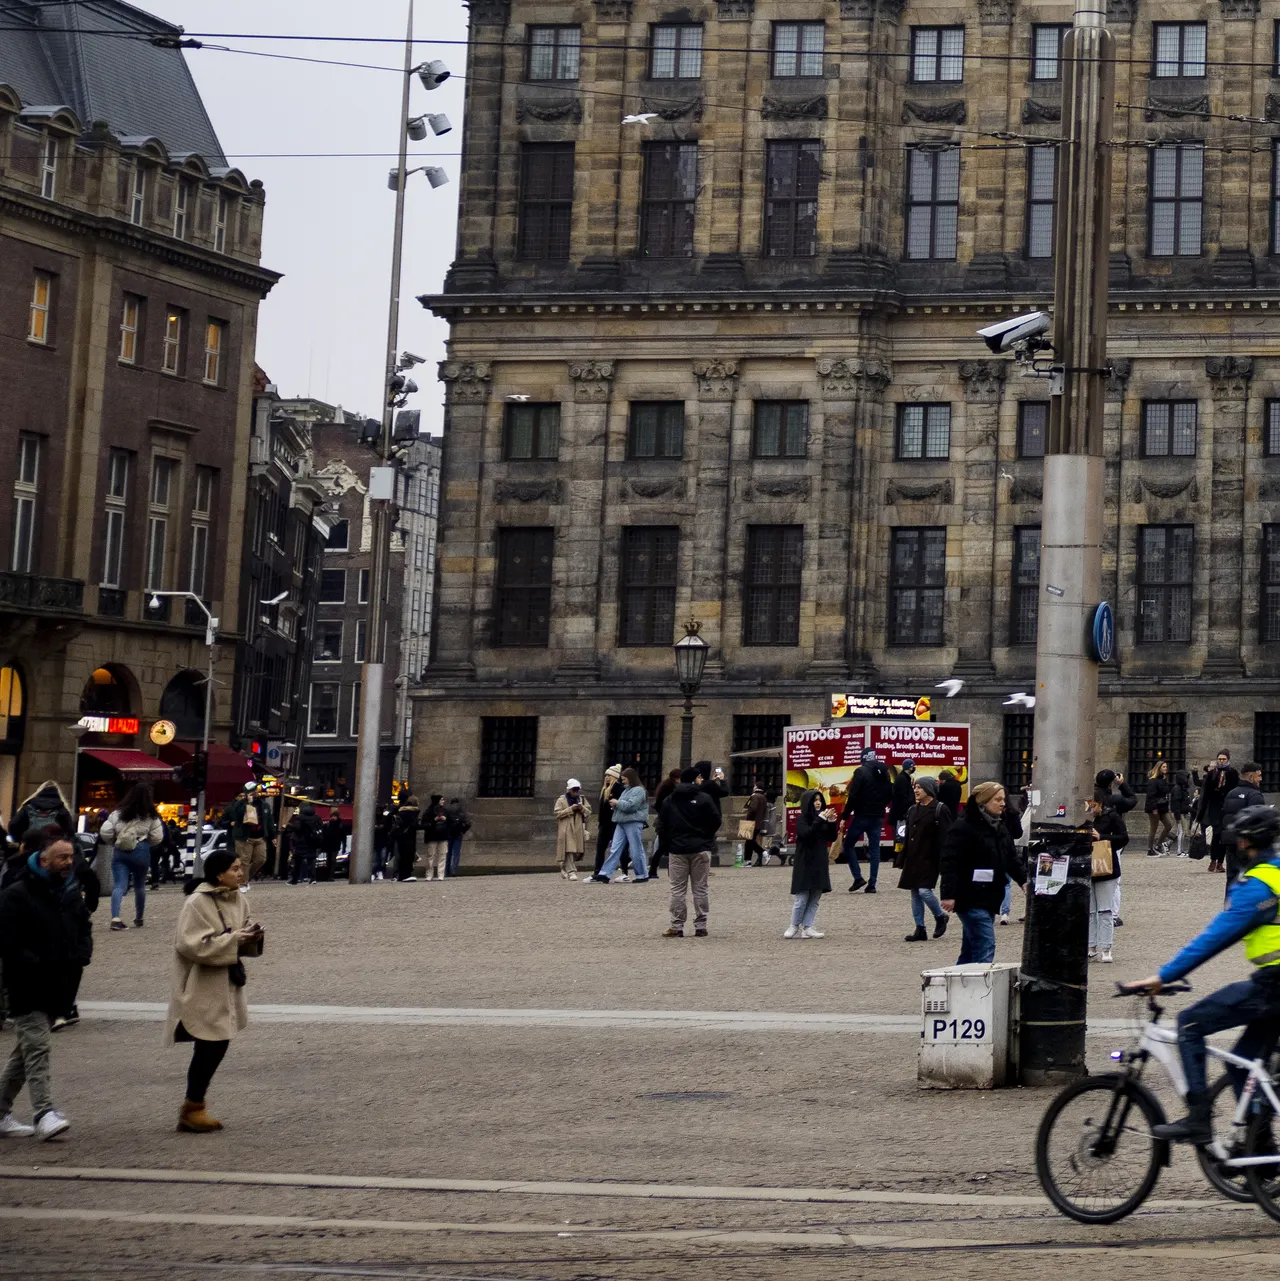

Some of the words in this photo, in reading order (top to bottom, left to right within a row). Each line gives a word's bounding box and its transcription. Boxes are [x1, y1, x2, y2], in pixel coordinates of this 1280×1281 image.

[788, 728, 841, 743] HOTDOGS
[880, 726, 935, 741] HOTDOGS
[933, 1019, 986, 1039] P129
